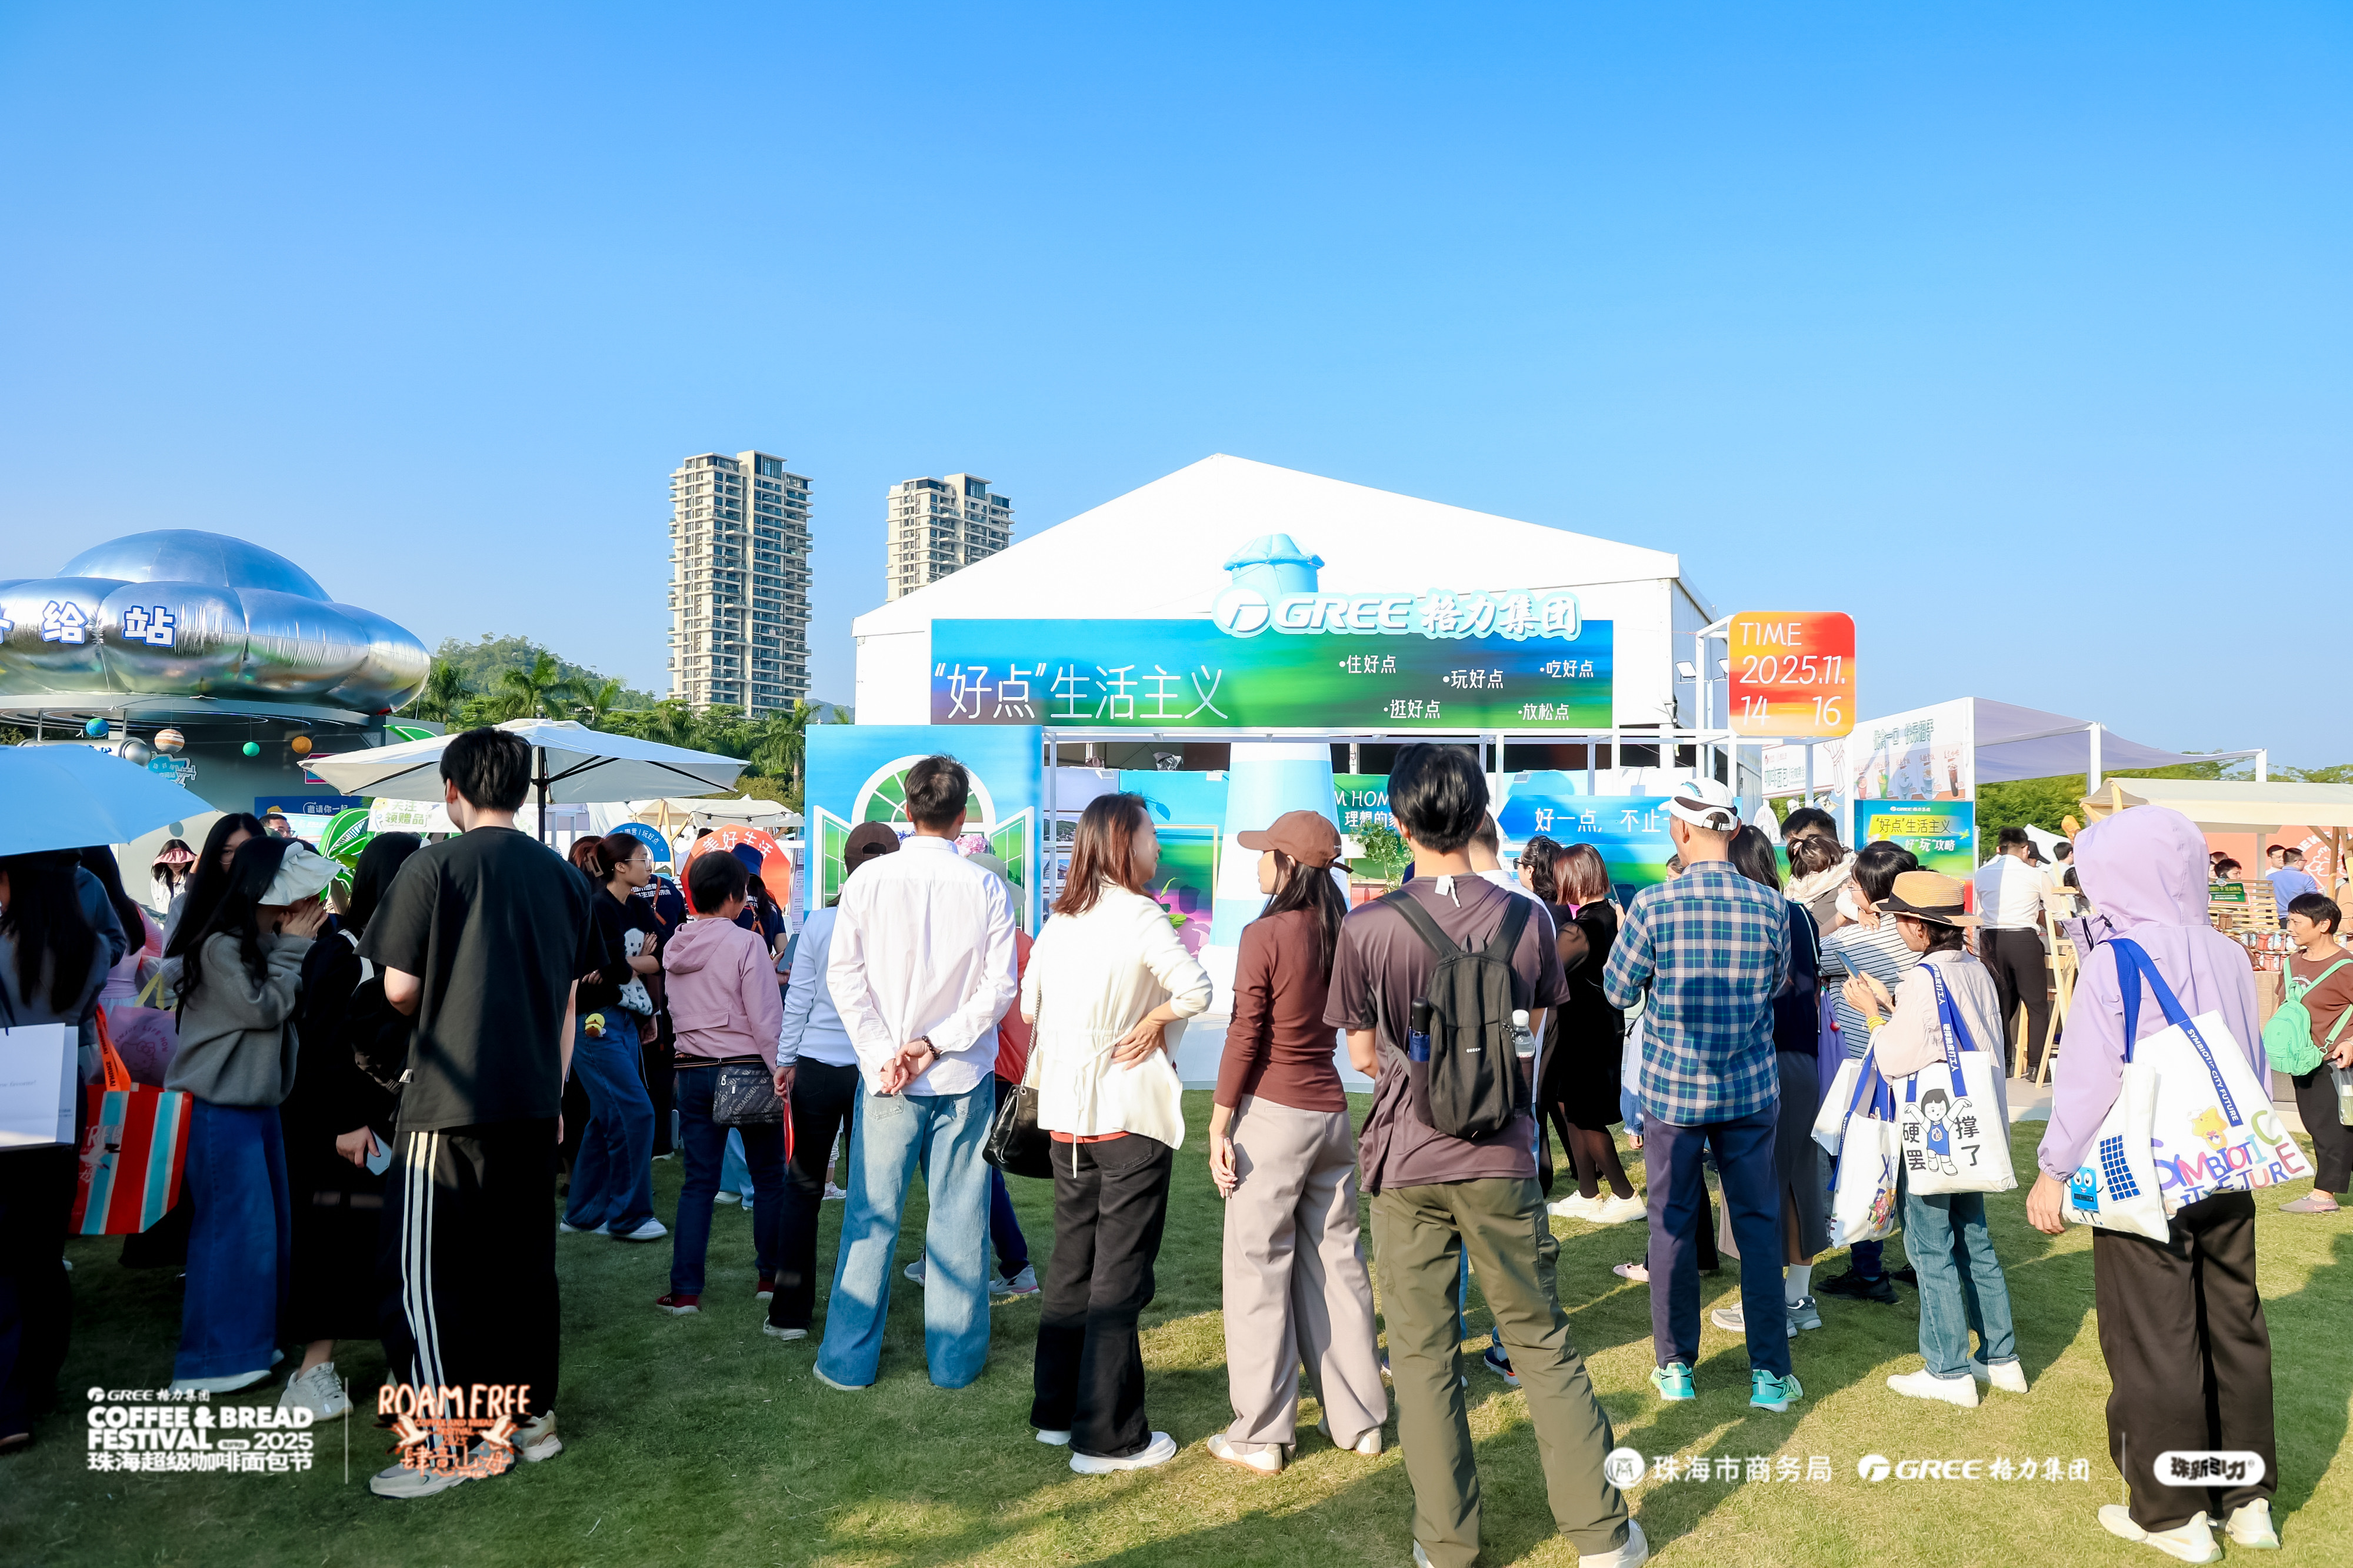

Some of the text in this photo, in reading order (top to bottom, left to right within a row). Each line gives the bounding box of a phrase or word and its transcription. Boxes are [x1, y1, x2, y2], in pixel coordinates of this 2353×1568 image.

[0, 600, 176, 648] 给站
[1275, 592, 1580, 636] GREE 格力集团
[1739, 621, 1802, 646] TIME
[1739, 655, 1846, 685] 2025.11.
[1740, 695, 1771, 726] 14
[1812, 695, 1842, 727] 16
[1351, 790, 1389, 807] HOM
[1621, 809, 1671, 833] 不止
[105, 1060, 116, 1087] ZHUHAI
[2212, 1070, 2224, 1087] CITY
[2219, 1088, 2239, 1122] FUTURE
[86, 1124, 123, 1147] REE
